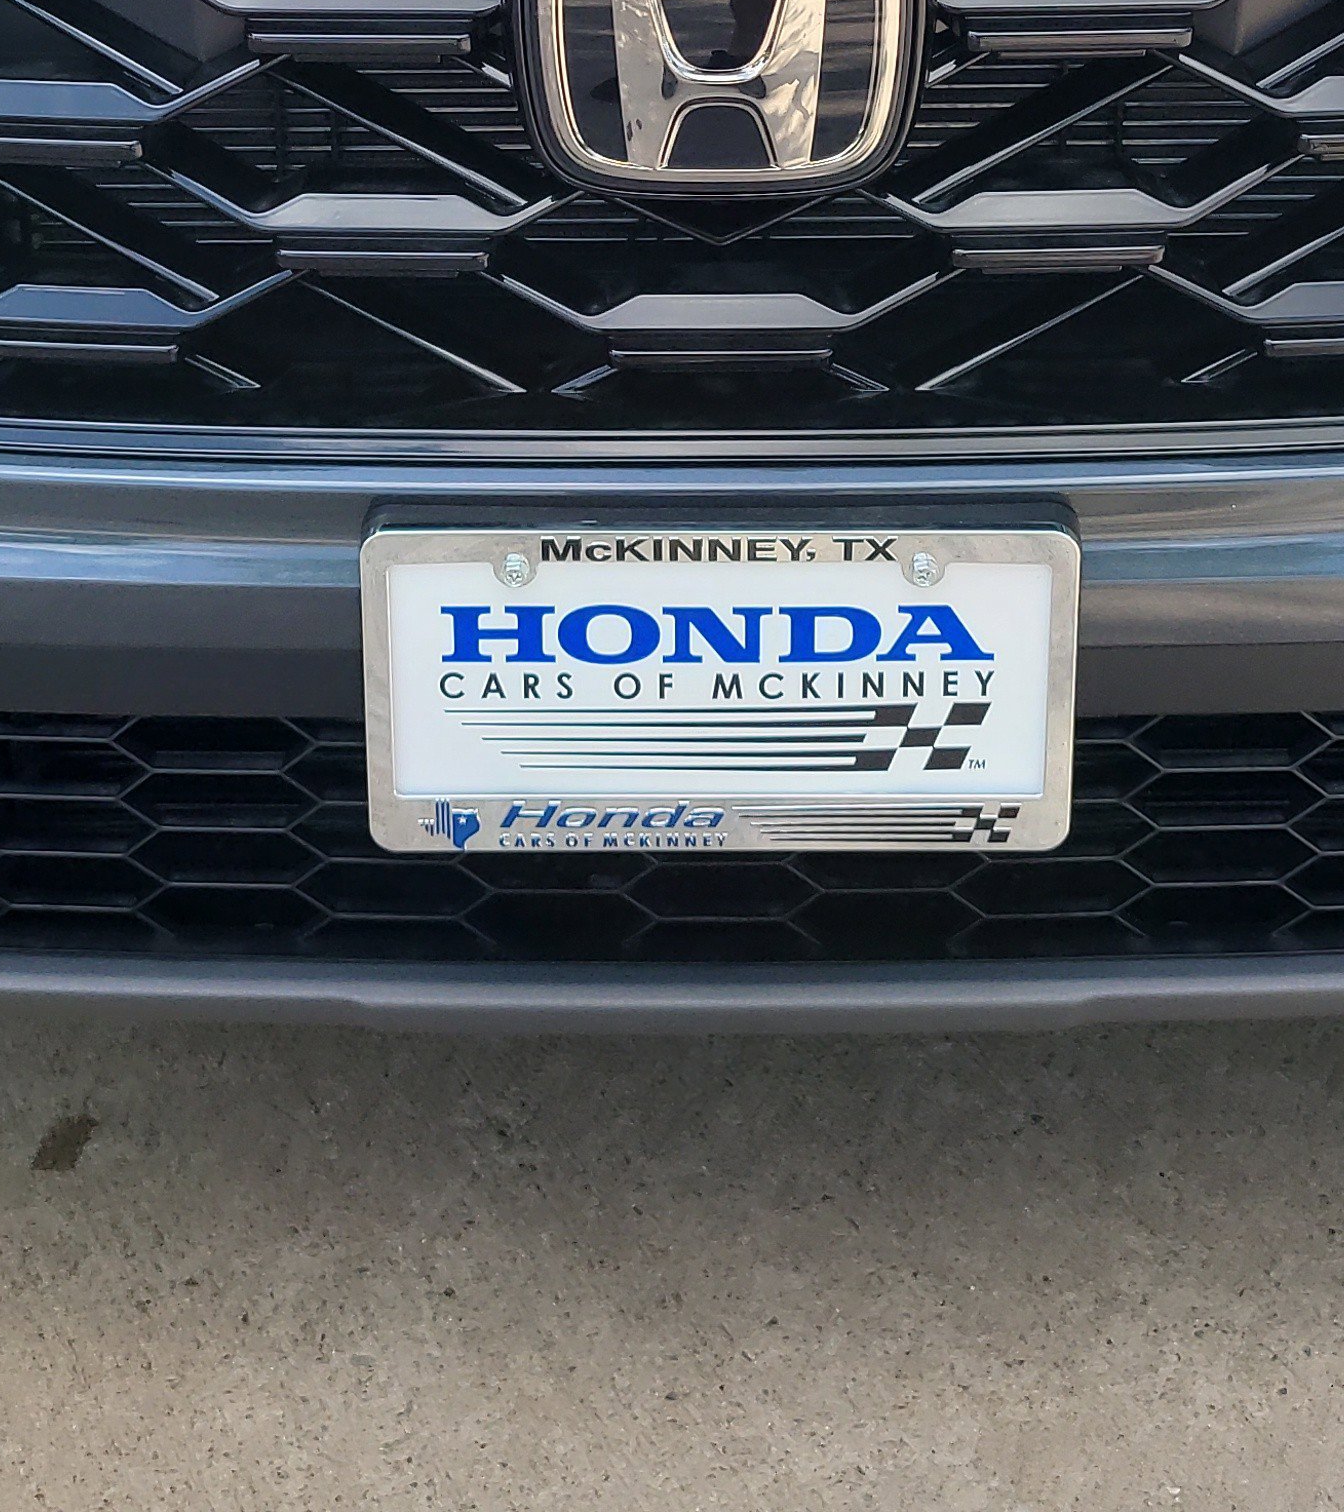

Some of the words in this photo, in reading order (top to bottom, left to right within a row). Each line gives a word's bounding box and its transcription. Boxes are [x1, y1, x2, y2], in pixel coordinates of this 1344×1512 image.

[540, 535, 817, 562] McKINNEY,
[832, 535, 899, 562] TX
[440, 604, 995, 664] HONDA
[439, 672, 573, 700] CARS
[613, 673, 674, 700] OF
[711, 671, 995, 700] MCKINNEY
[499, 799, 726, 828] Honda
[499, 832, 555, 848] CARS
[565, 832, 593, 848] OF
[602, 832, 728, 848] MCKINNEY
